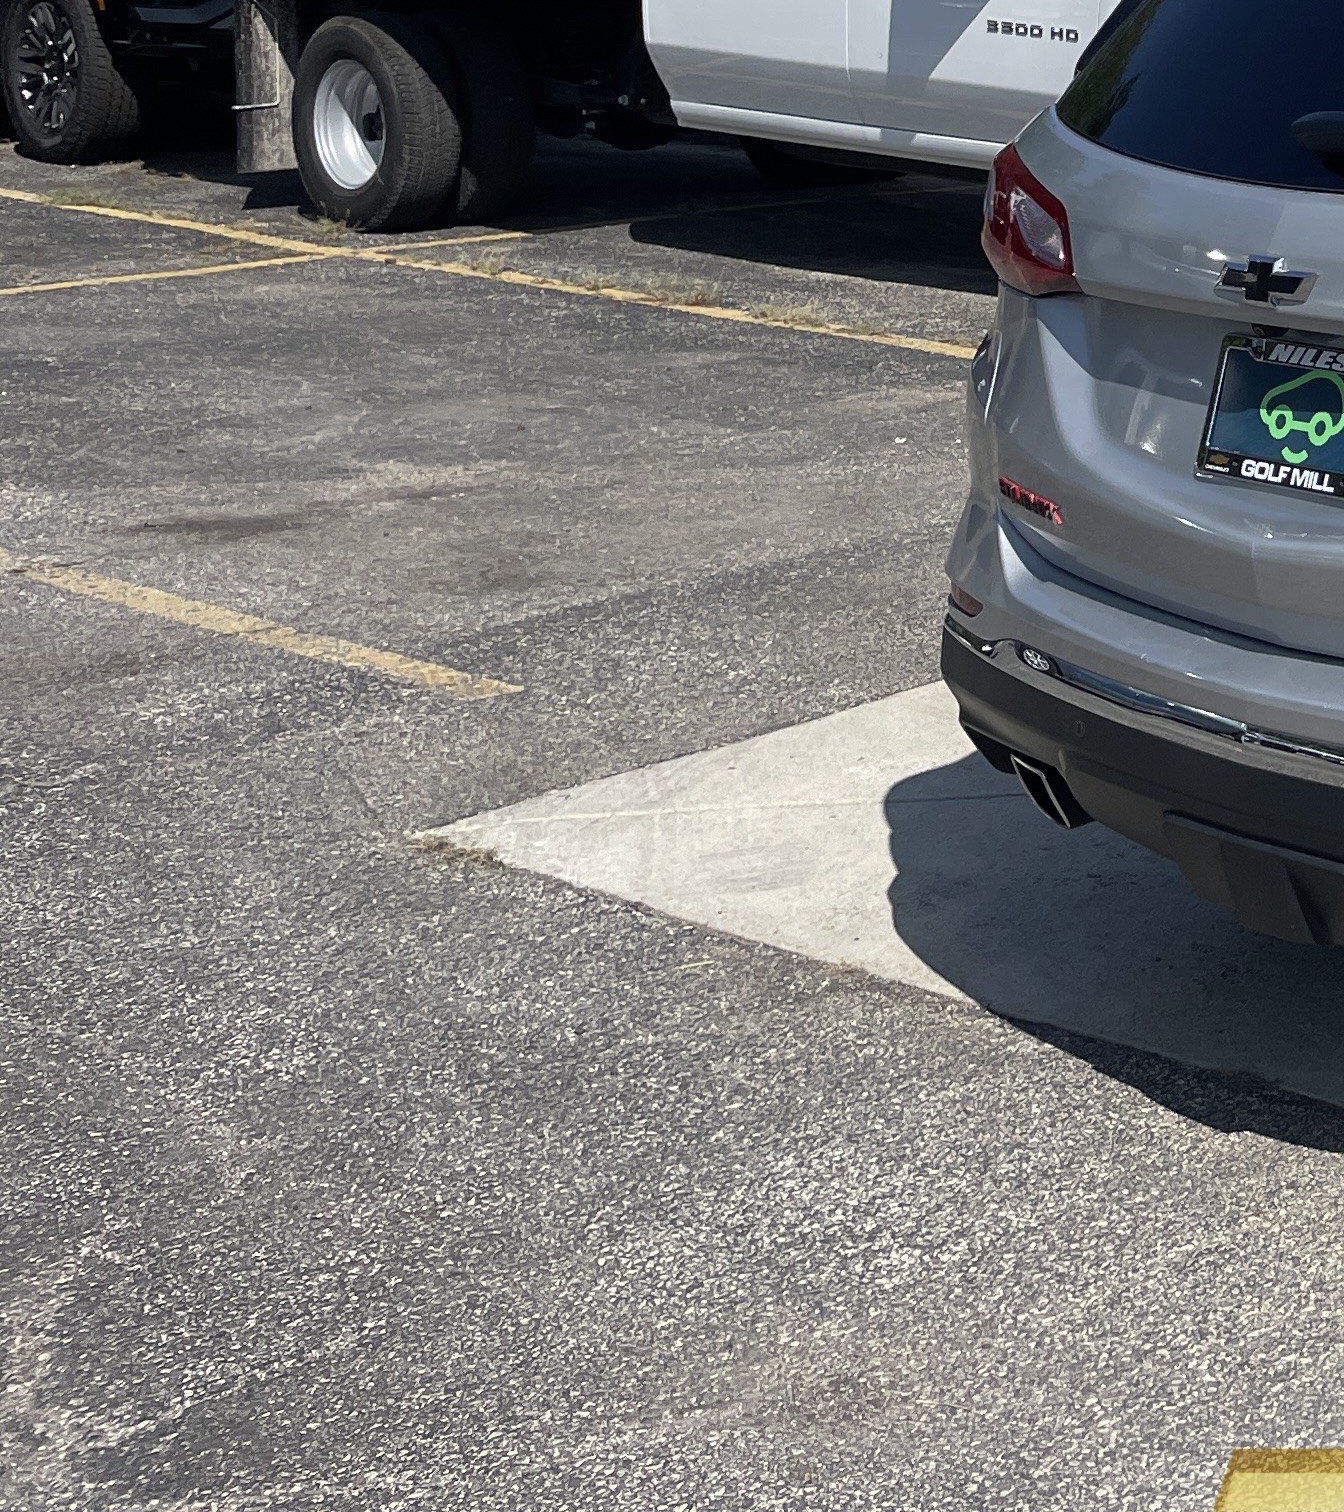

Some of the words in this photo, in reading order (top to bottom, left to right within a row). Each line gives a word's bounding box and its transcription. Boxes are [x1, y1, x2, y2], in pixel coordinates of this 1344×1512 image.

[1050, 26, 1079, 43] HD
[1241, 459, 1291, 484] GOLF
[1290, 468, 1335, 493] MILL
